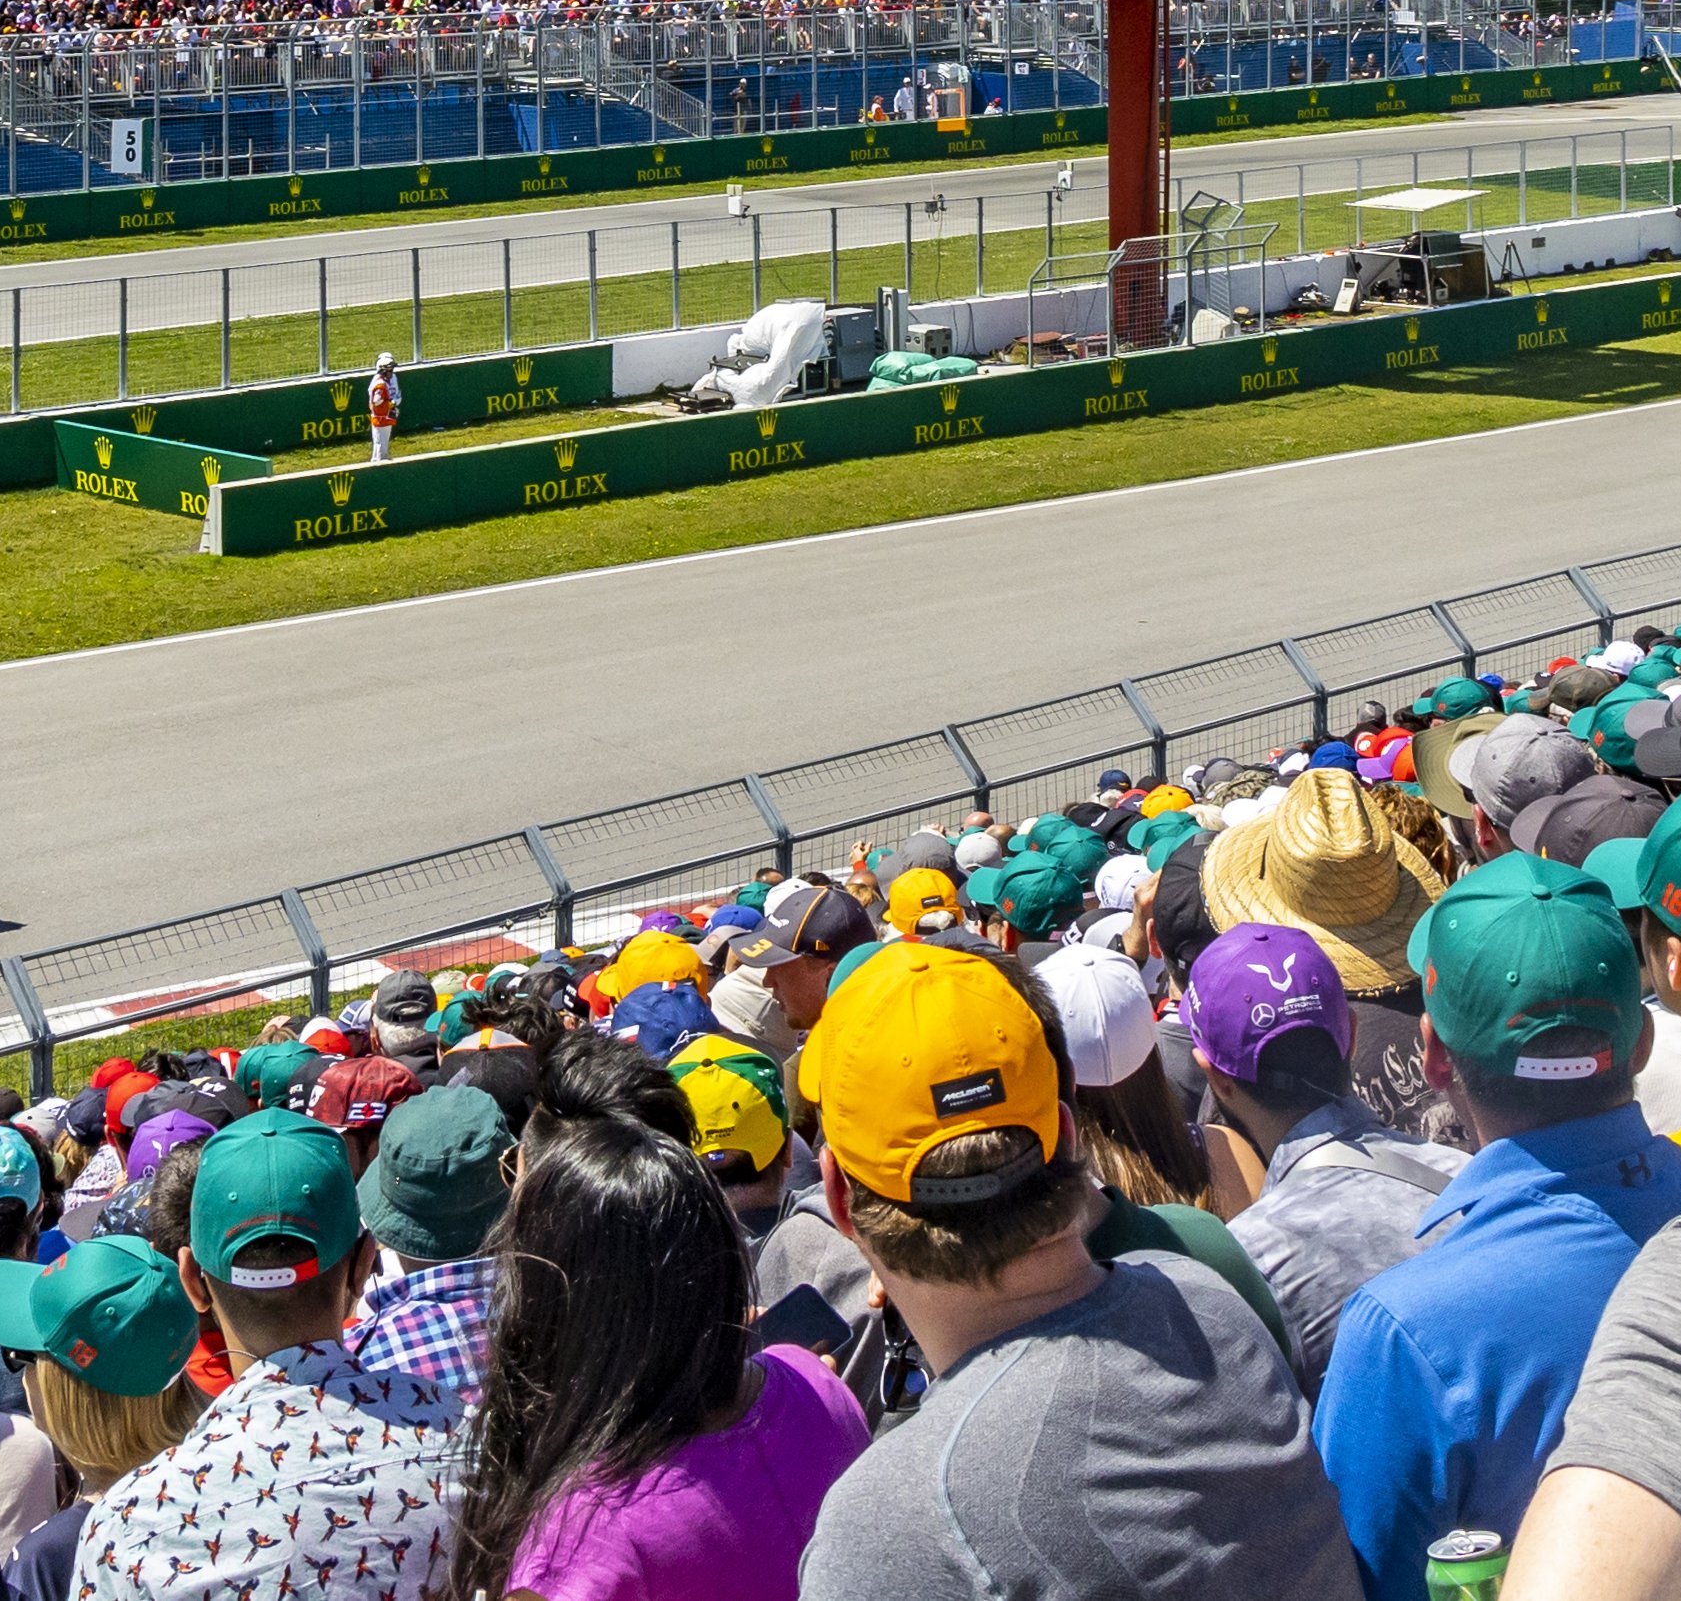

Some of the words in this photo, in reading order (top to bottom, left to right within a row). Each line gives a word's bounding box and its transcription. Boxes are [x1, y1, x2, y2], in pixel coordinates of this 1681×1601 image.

[1376, 100, 1406, 111] ROLEX
[1451, 93, 1480, 104] ROLEX
[1217, 115, 1249, 126] ROLEX
[1298, 107, 1328, 119] ROLEX
[1043, 131, 1078, 143] ROLEX
[851, 148, 889, 161] ROLEX
[948, 140, 985, 153] ROLEX
[747, 157, 787, 170] ROLEX
[638, 166, 681, 181] ROLEX
[522, 177, 568, 191] ROLEX
[400, 189, 448, 203] ROLEX
[270, 199, 320, 215] ROLEX
[120, 212, 174, 228] ROLEX
[1518, 328, 1568, 350] ROLEX
[1386, 346, 1439, 368] ROLEX
[1241, 368, 1298, 392] ROLEX
[487, 387, 558, 414] ROLEX
[1085, 390, 1147, 416] ROLEX
[303, 413, 371, 440] ROLE
[915, 417, 983, 443] ROLEX
[730, 441, 805, 471] ROLEX
[76, 470, 139, 501] ROLEX
[525, 473, 607, 504] ROLEX
[295, 508, 387, 540] ROLEX
[942, 1084, 990, 1103] McLaren
[69, 1339, 98, 1369] 18
